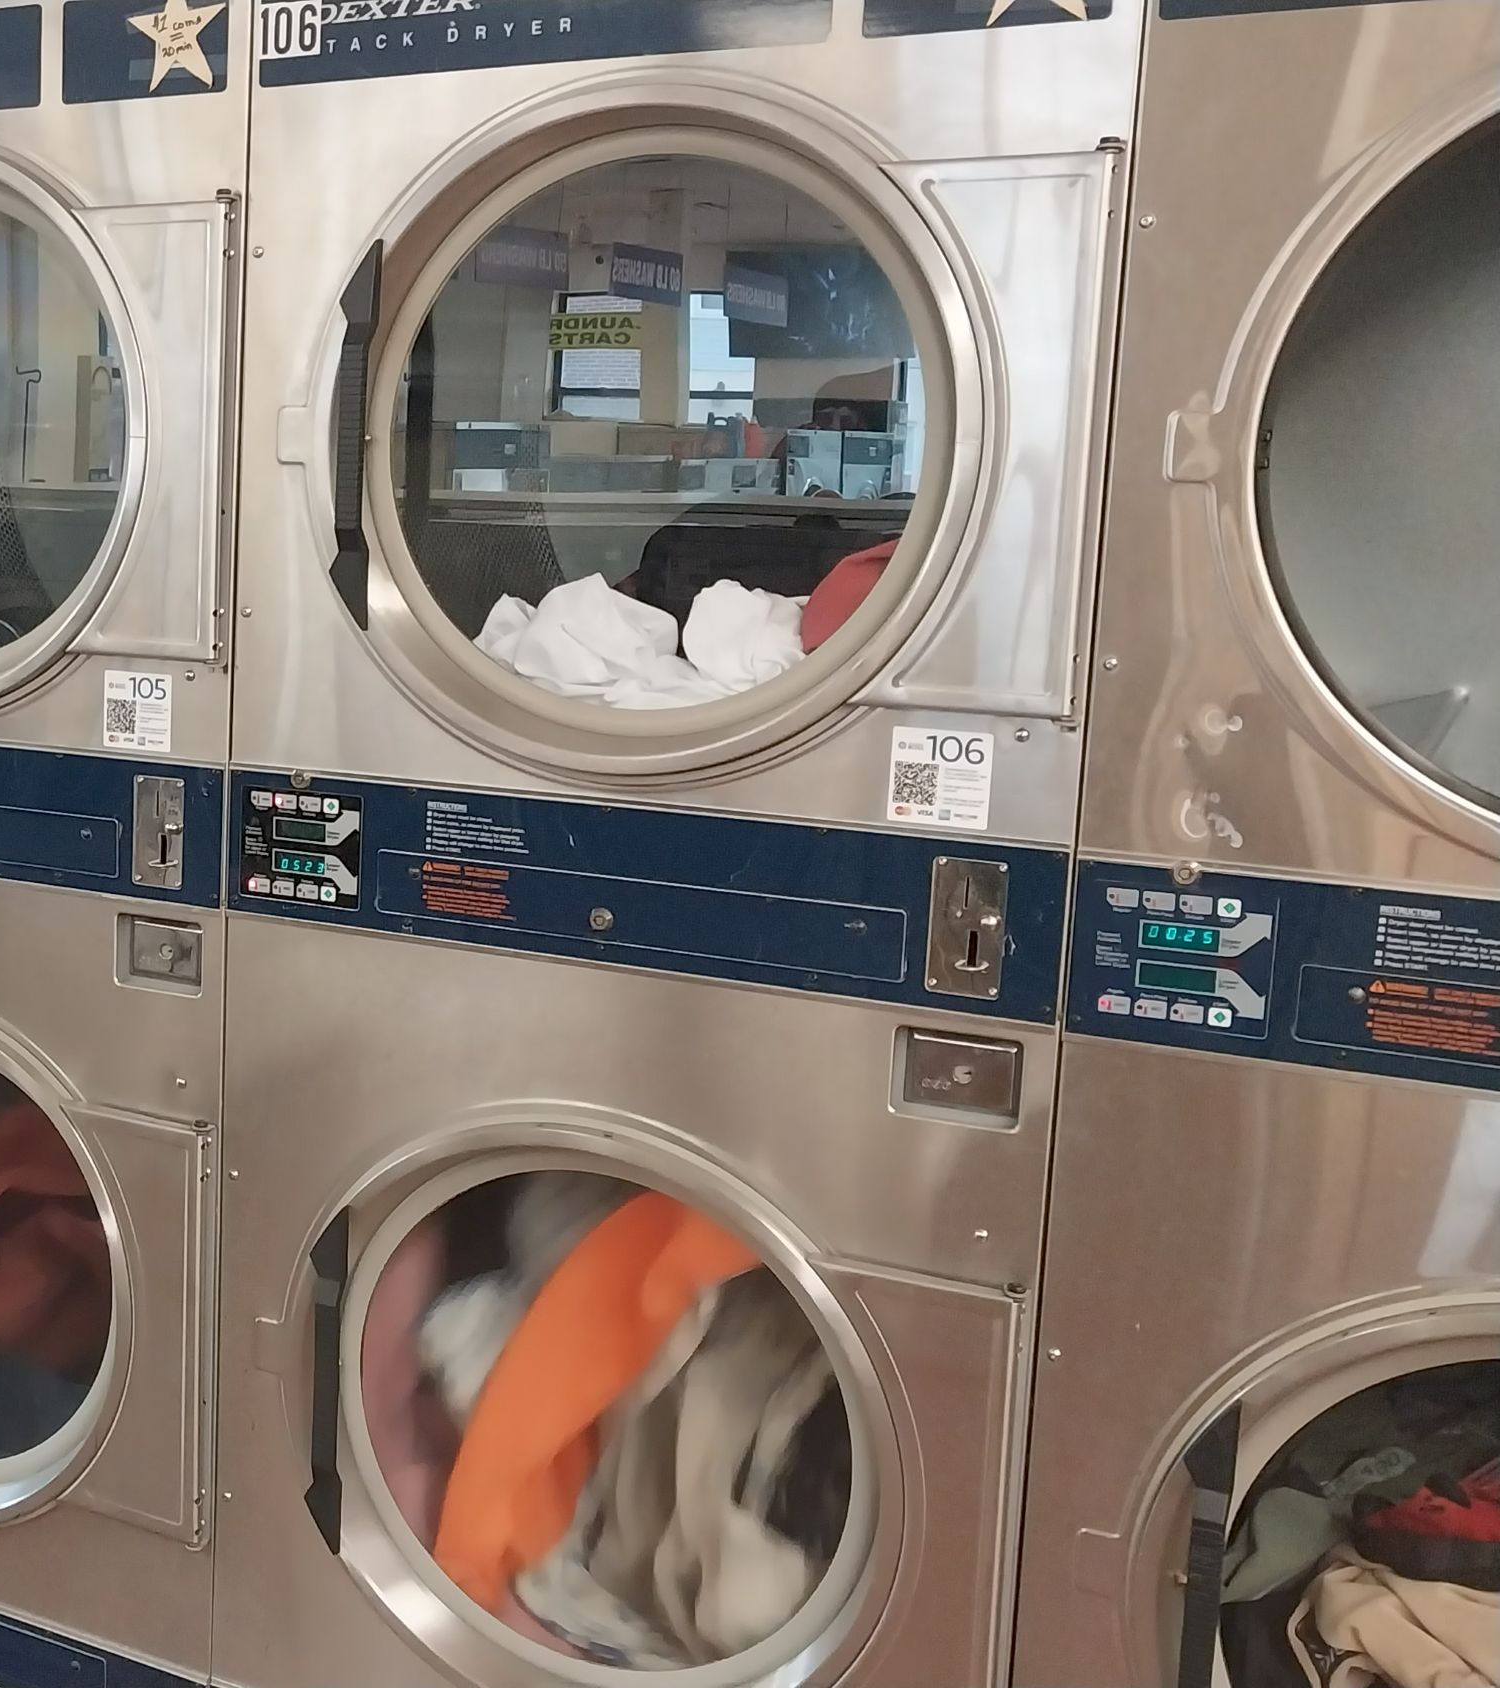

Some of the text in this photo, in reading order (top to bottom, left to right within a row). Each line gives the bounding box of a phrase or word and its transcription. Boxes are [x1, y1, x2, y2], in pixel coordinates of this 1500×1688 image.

[260, 5, 318, 55] 106
[326, 17, 571, 53] TACK DRYER
[161, 42, 193, 57] 20 min
[129, 677, 167, 700] 105
[926, 735, 985, 765] 106
[281, 858, 325, 874] 0523
